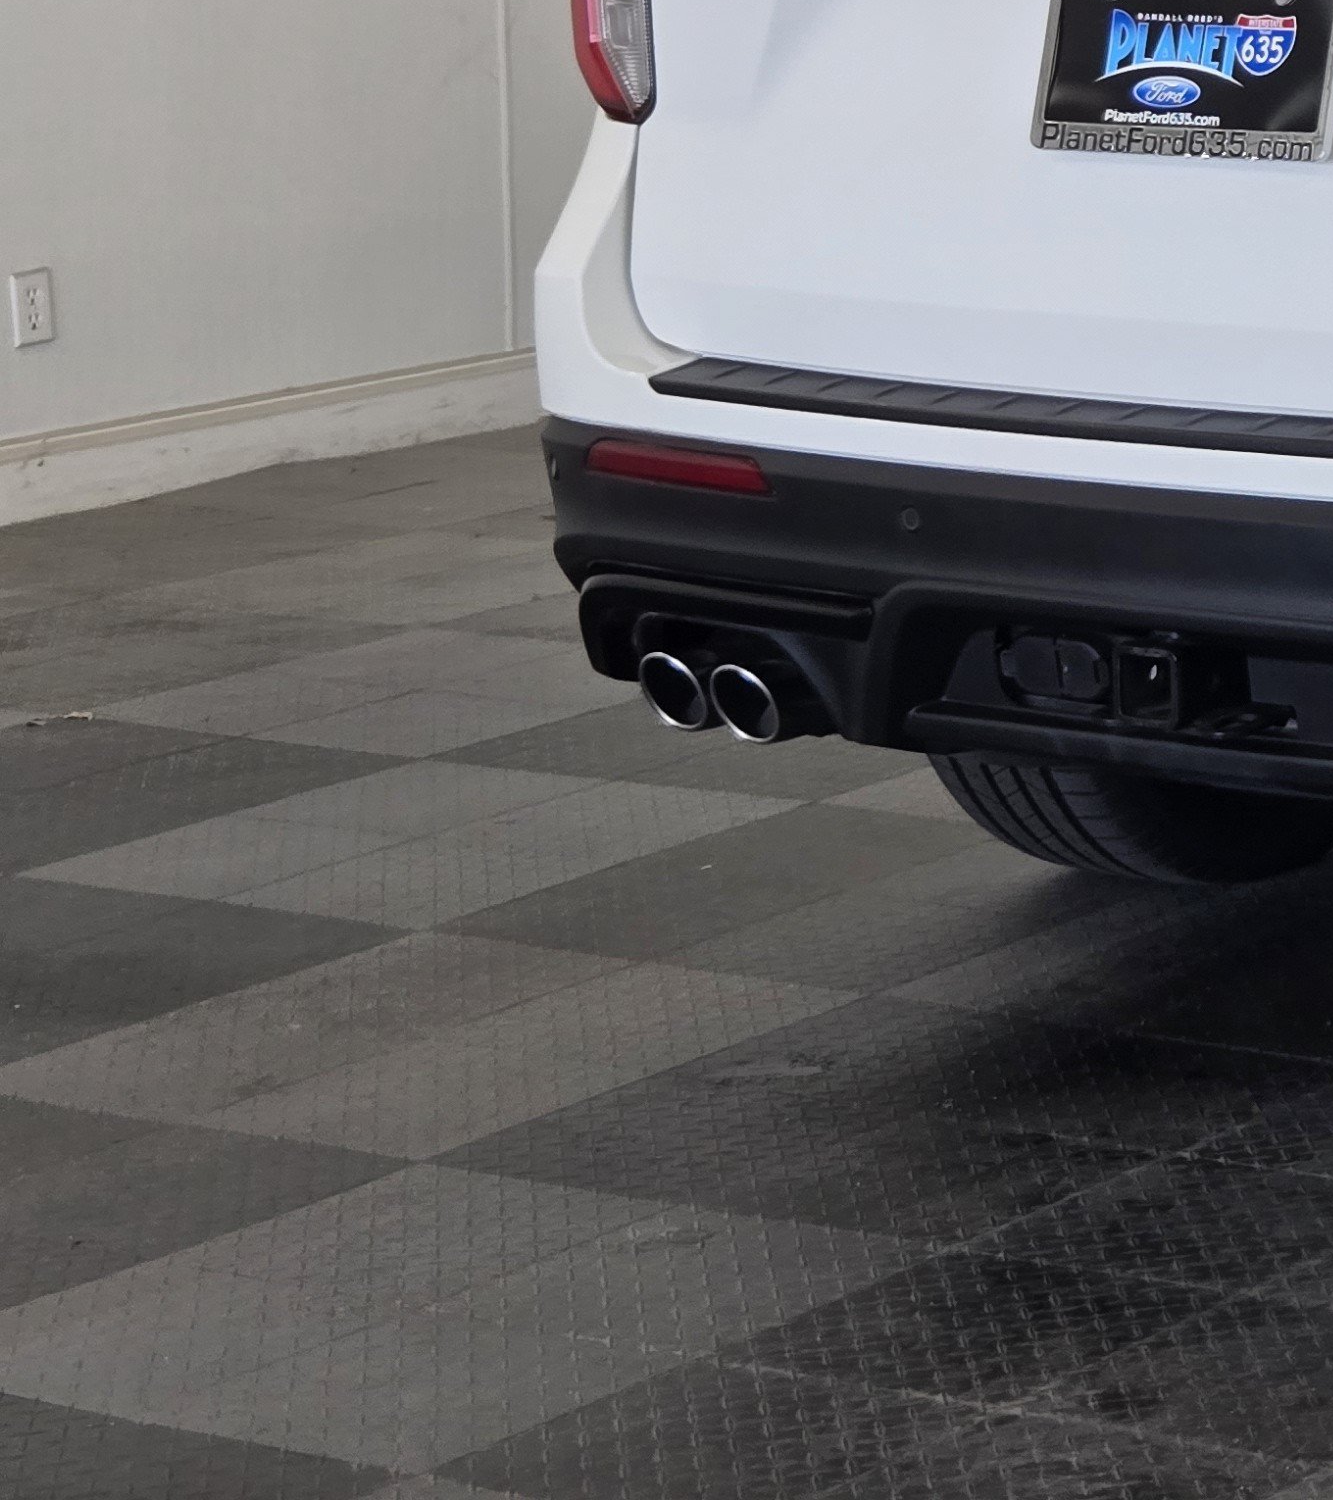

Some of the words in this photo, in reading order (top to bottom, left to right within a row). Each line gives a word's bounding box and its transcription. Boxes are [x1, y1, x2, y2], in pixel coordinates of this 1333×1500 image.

[1104, 8, 1244, 78] PLANET
[1241, 35, 1285, 64] 635
[1145, 78, 1186, 104] Ford
[1104, 109, 1220, 127] PlanetFord635.com
[1040, 123, 1314, 161] PlanetFord635.com
